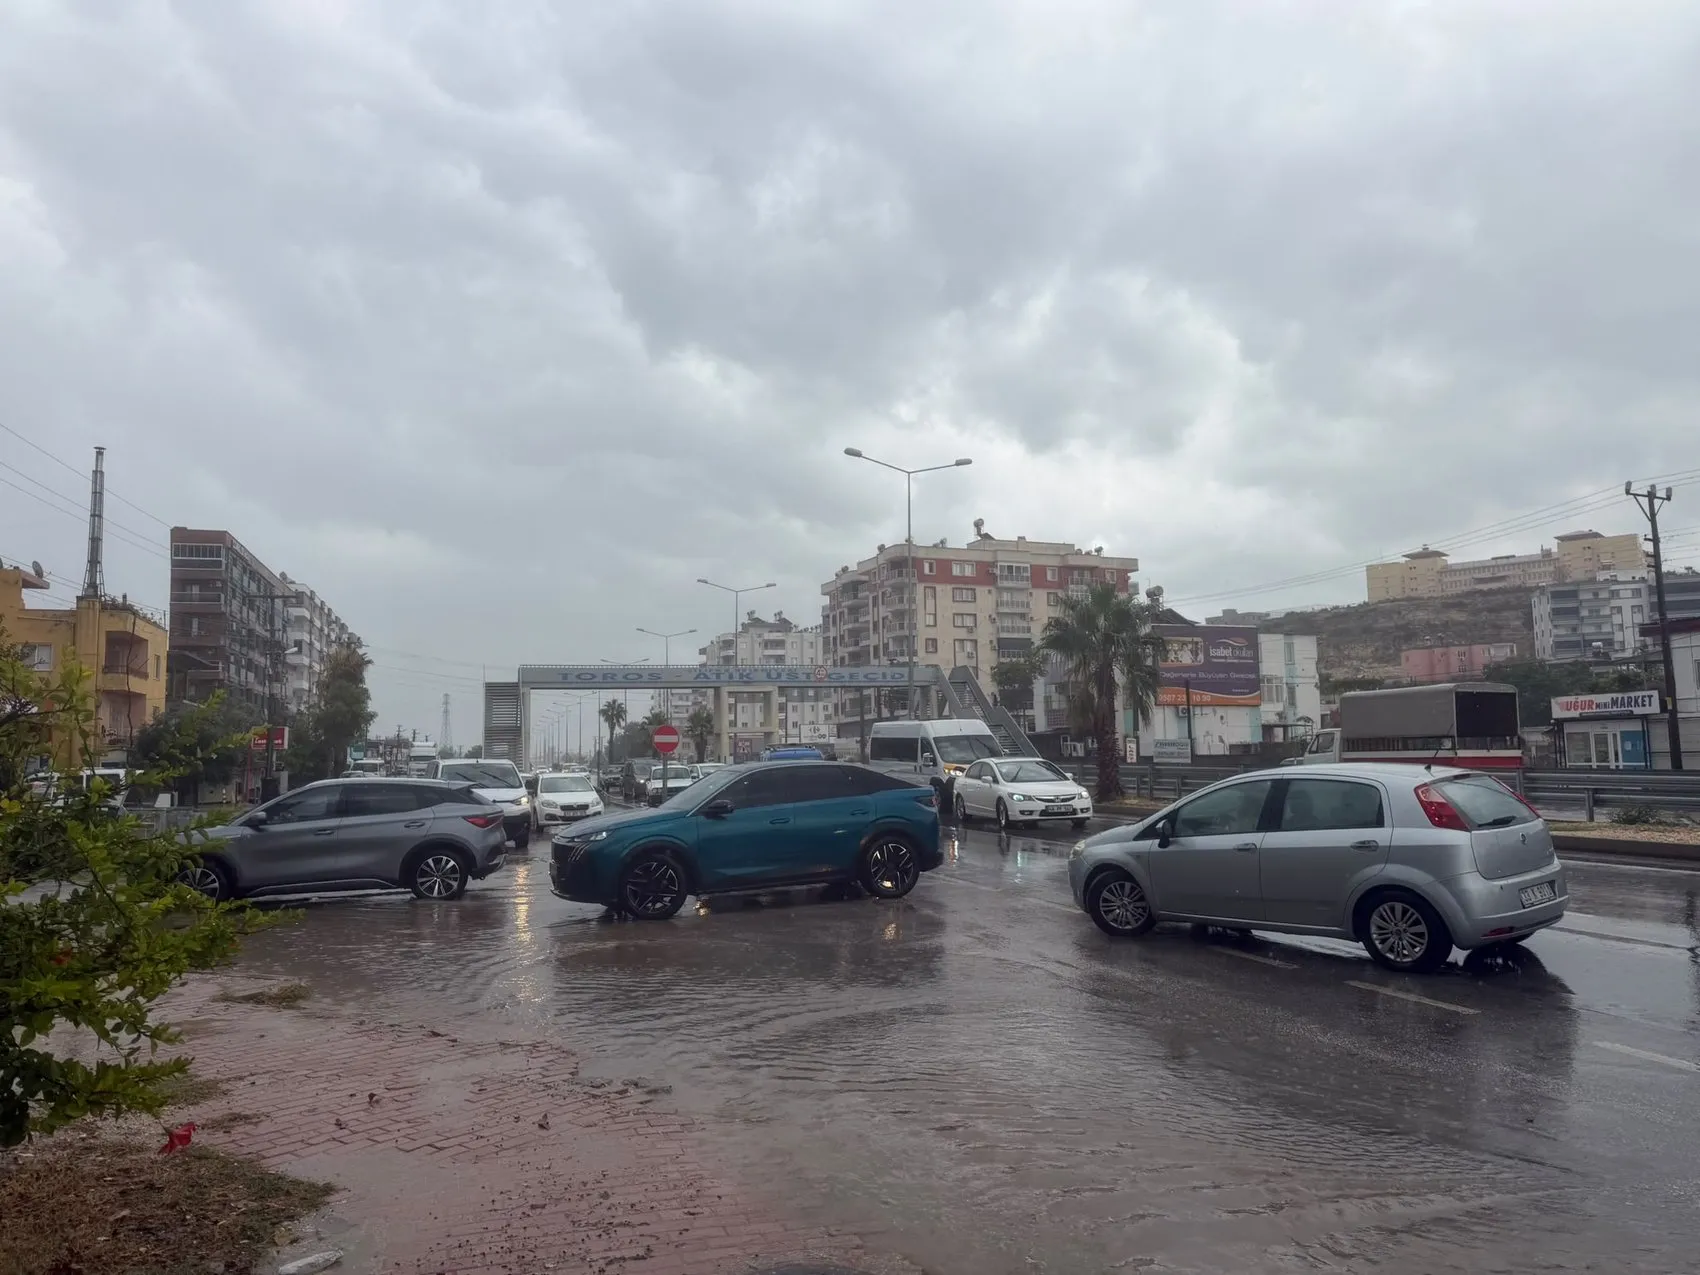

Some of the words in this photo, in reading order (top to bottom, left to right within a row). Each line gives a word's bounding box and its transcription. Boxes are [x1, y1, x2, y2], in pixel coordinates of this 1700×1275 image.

[557, 671, 663, 681] TOROS
[1565, 696, 1595, 712] UĞUR
[1610, 694, 1654, 710] MARKET
